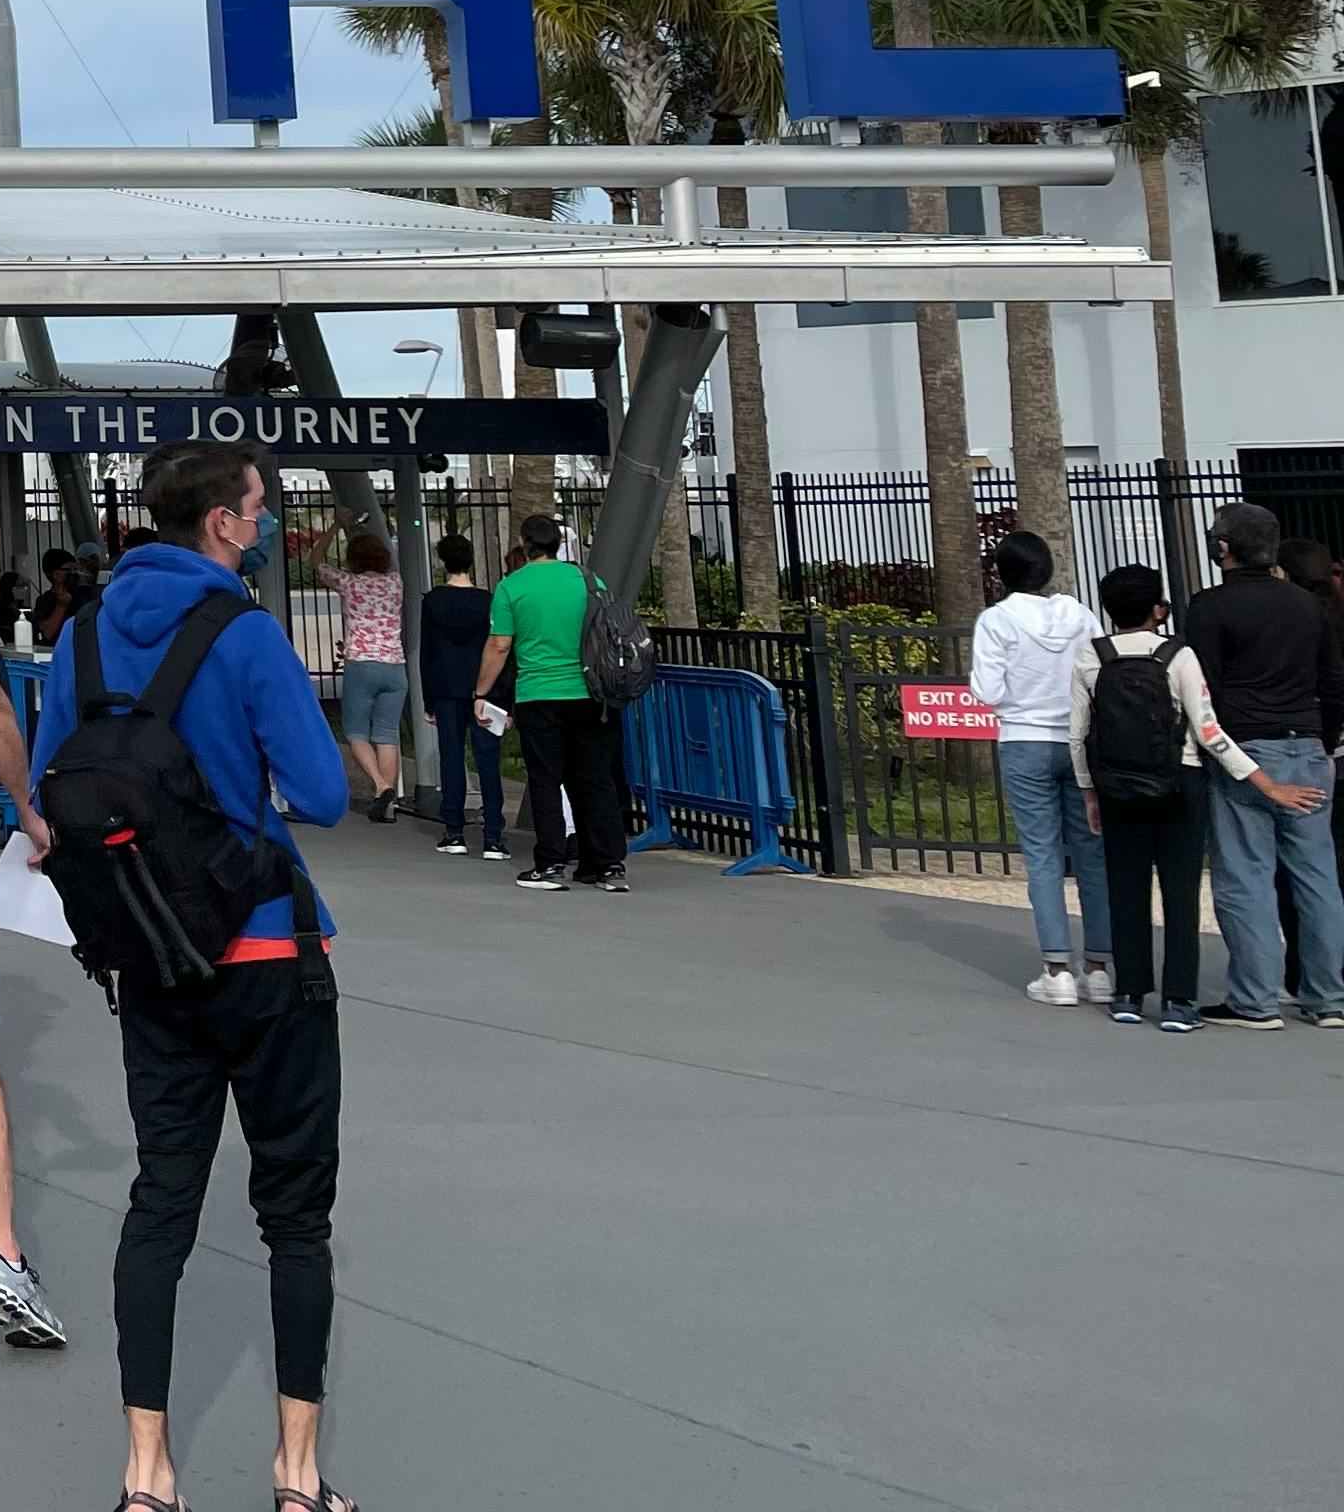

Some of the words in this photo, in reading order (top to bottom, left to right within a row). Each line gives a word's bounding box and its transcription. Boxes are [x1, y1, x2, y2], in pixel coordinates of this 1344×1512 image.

[65, 406, 157, 443] THE
[187, 406, 424, 444] JOURNEY
[918, 691, 954, 706] EXIT
[907, 712, 932, 726] NO
[937, 713, 1001, 728] RE-ENT
